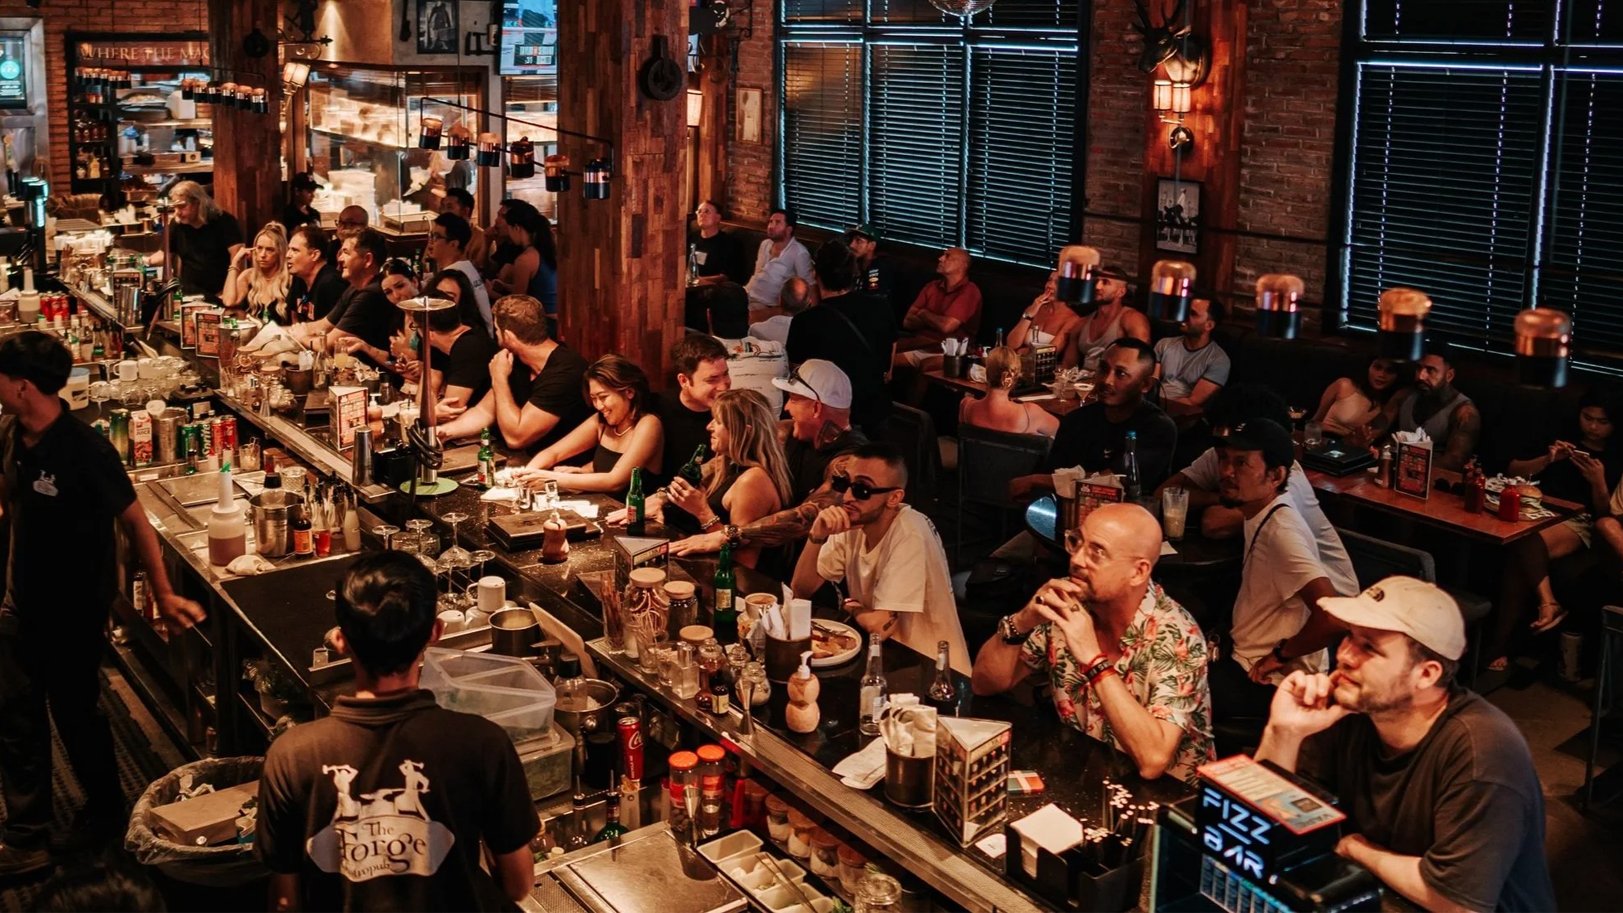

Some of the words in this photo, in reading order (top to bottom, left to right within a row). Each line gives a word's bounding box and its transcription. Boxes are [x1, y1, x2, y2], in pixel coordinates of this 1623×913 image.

[144, 46, 174, 60] THE
[202, 424, 211, 455] Sprite
[362, 821, 395, 837] The
[1203, 787, 1271, 845] FIZZ
[334, 828, 427, 873] Forge
[1203, 825, 1265, 879] BAR
